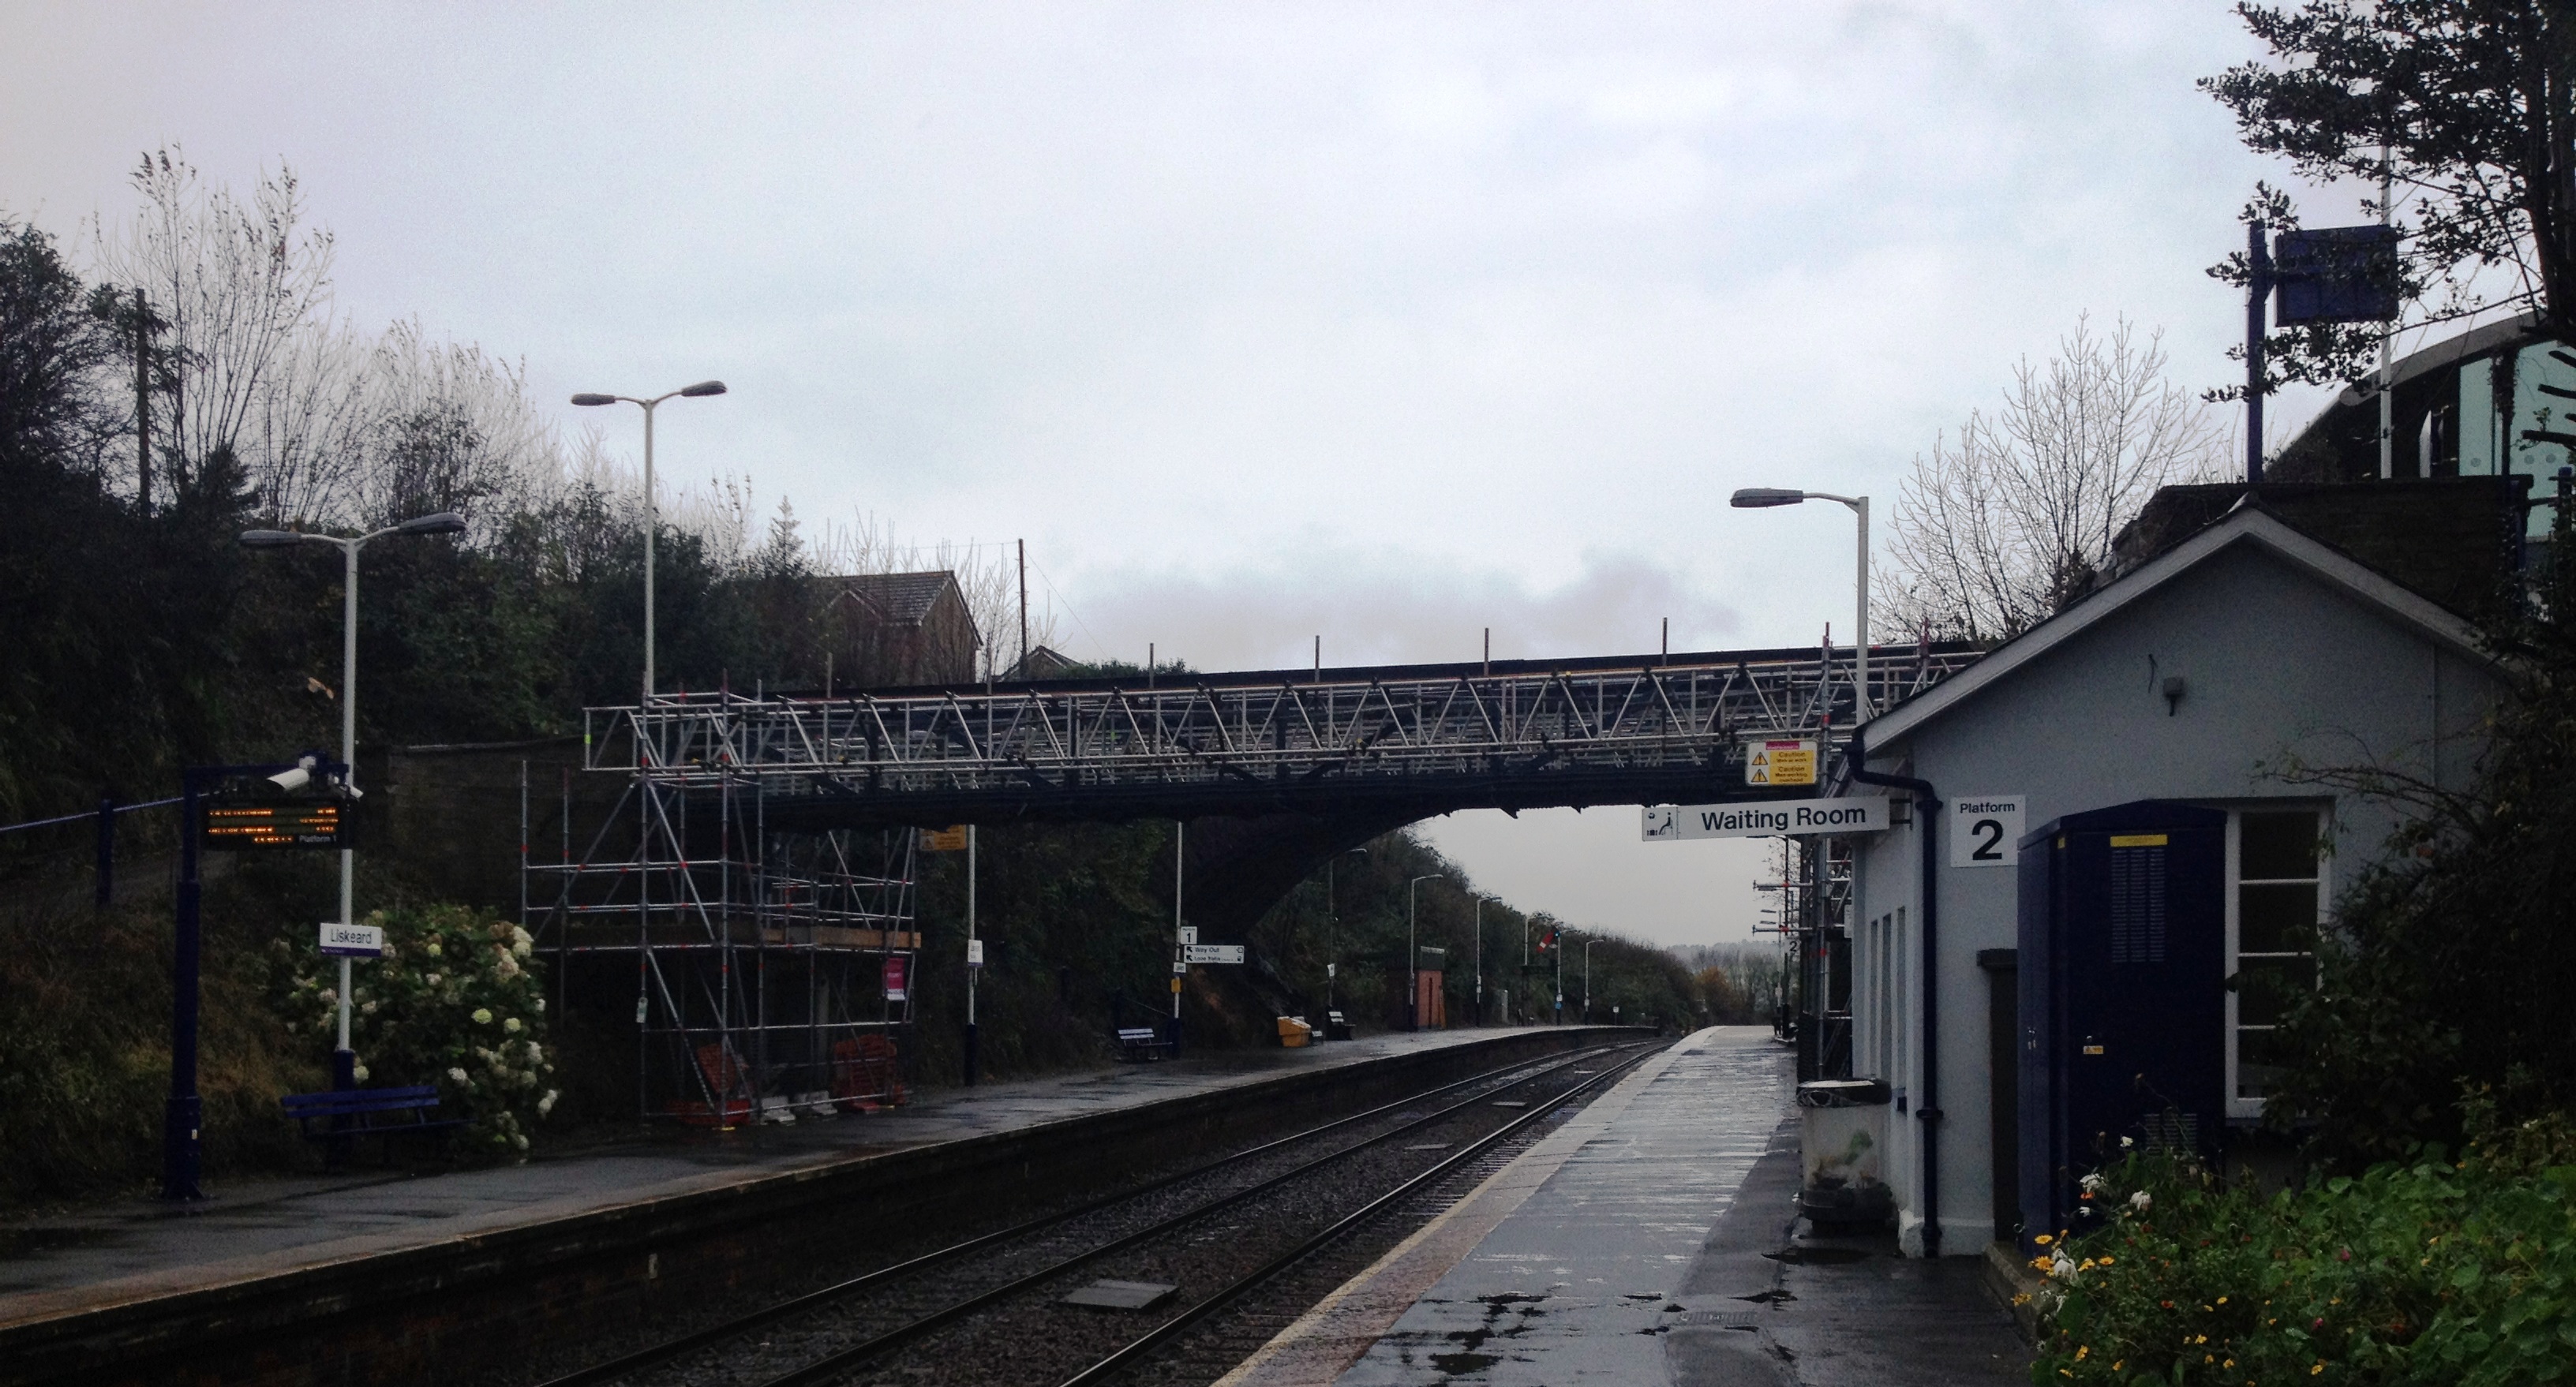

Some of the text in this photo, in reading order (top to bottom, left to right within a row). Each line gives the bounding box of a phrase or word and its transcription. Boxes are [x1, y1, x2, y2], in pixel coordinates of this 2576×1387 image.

[1960, 802, 2015, 813] Platform
[1702, 807, 1866, 831] Waiting Room
[1971, 819, 2004, 861] 2
[331, 929, 372, 944] Liskeard
[1187, 933, 1191, 943] 1
[1789, 940, 1798, 952] 2
